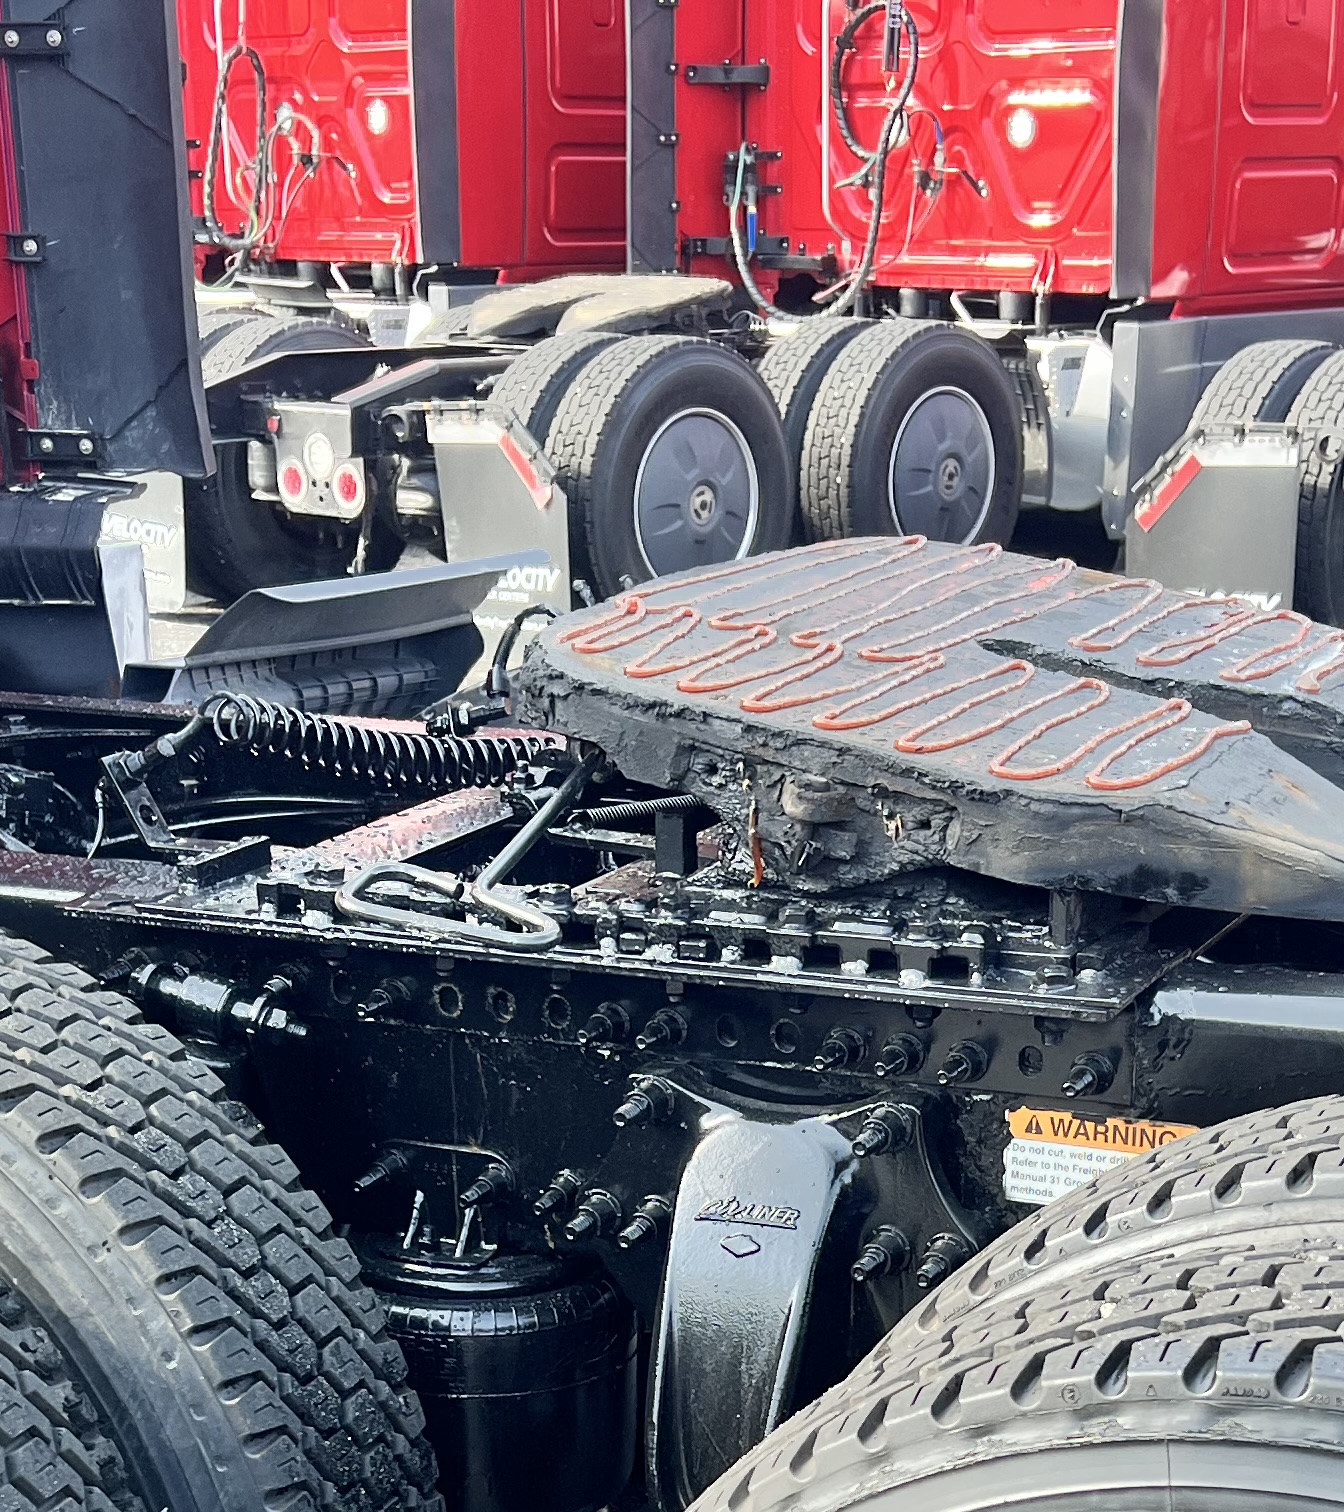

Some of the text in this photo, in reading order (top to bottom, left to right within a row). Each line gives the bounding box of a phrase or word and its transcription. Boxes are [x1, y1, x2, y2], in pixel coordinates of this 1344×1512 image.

[1012, 1142, 1026, 1153] Do
[1029, 1146, 1045, 1156] not
[1069, 1151, 1093, 1161] weld
[1096, 1155, 1107, 1163] or
[1011, 1156, 1038, 1168] Refer
[1041, 1161, 1051, 1170] to
[1053, 1162, 1070, 1173] the
[1010, 1170, 1047, 1183] Manual
[1049, 1175, 1061, 1185] 31
